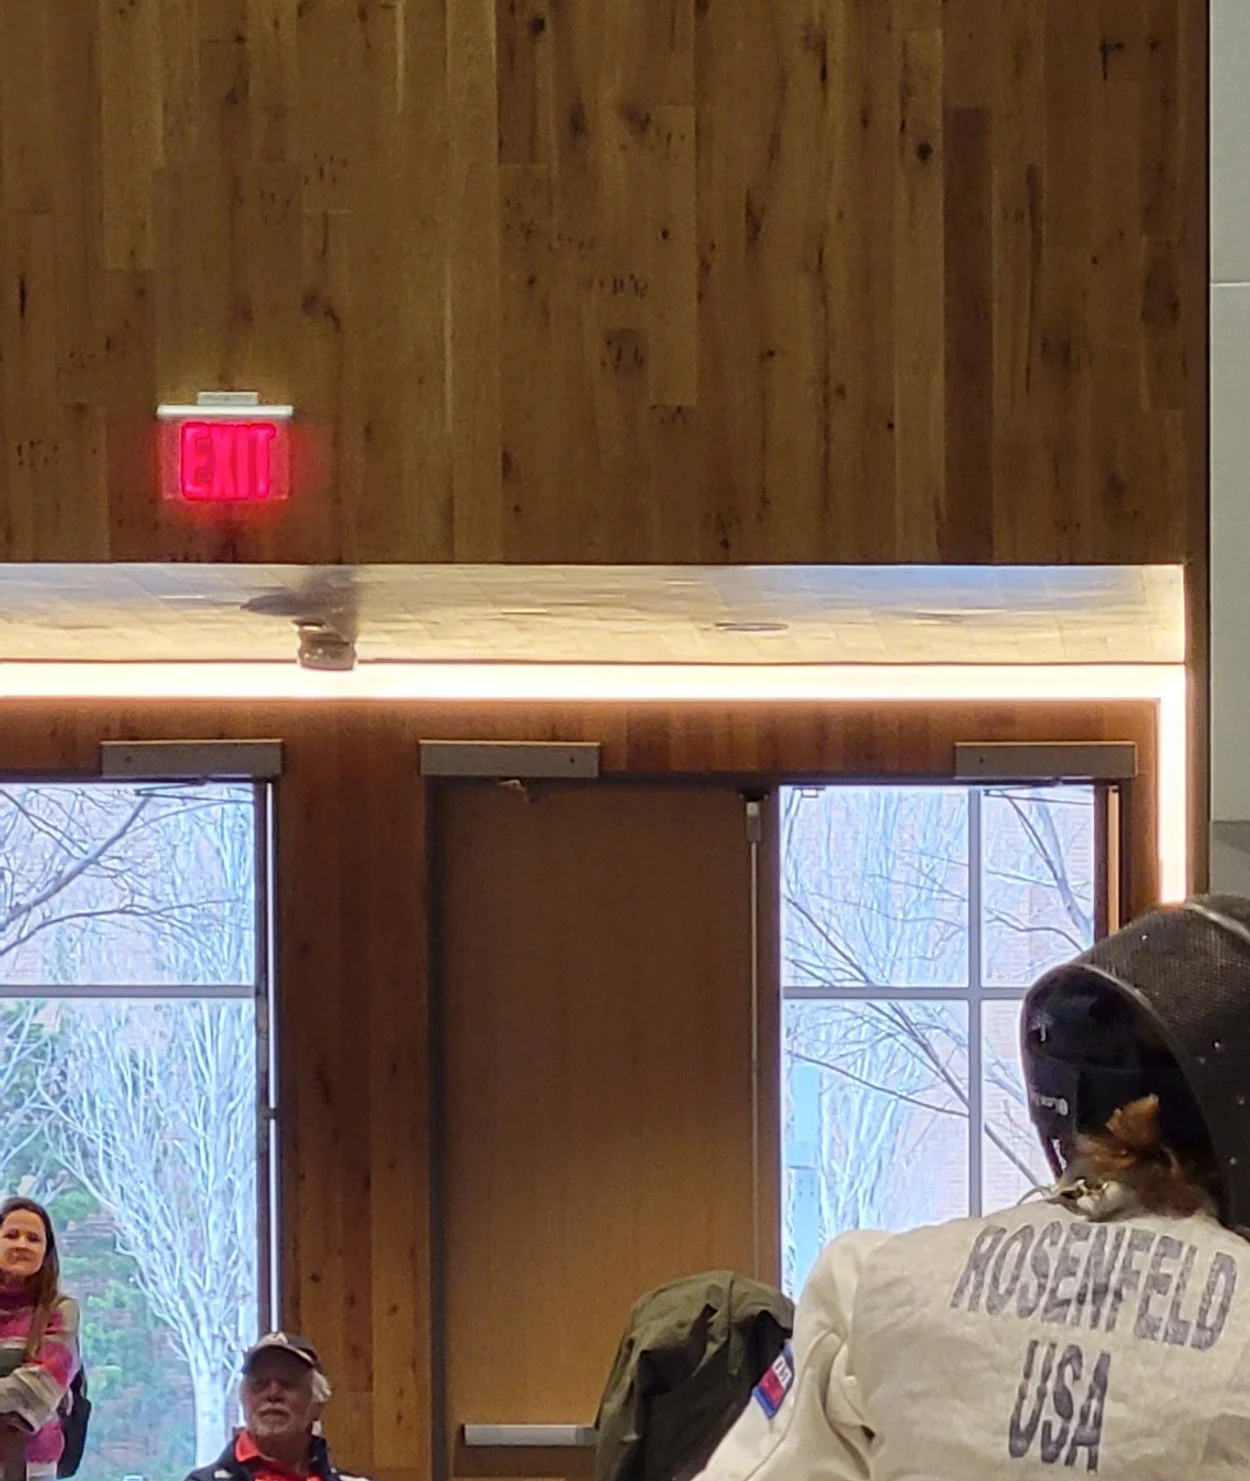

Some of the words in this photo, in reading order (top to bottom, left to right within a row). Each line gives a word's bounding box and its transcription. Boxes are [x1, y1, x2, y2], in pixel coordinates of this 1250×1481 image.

[181, 422, 276, 500] EXIT
[950, 1220, 1238, 1350] ROSENFELD
[1008, 1339, 1111, 1473] USA
